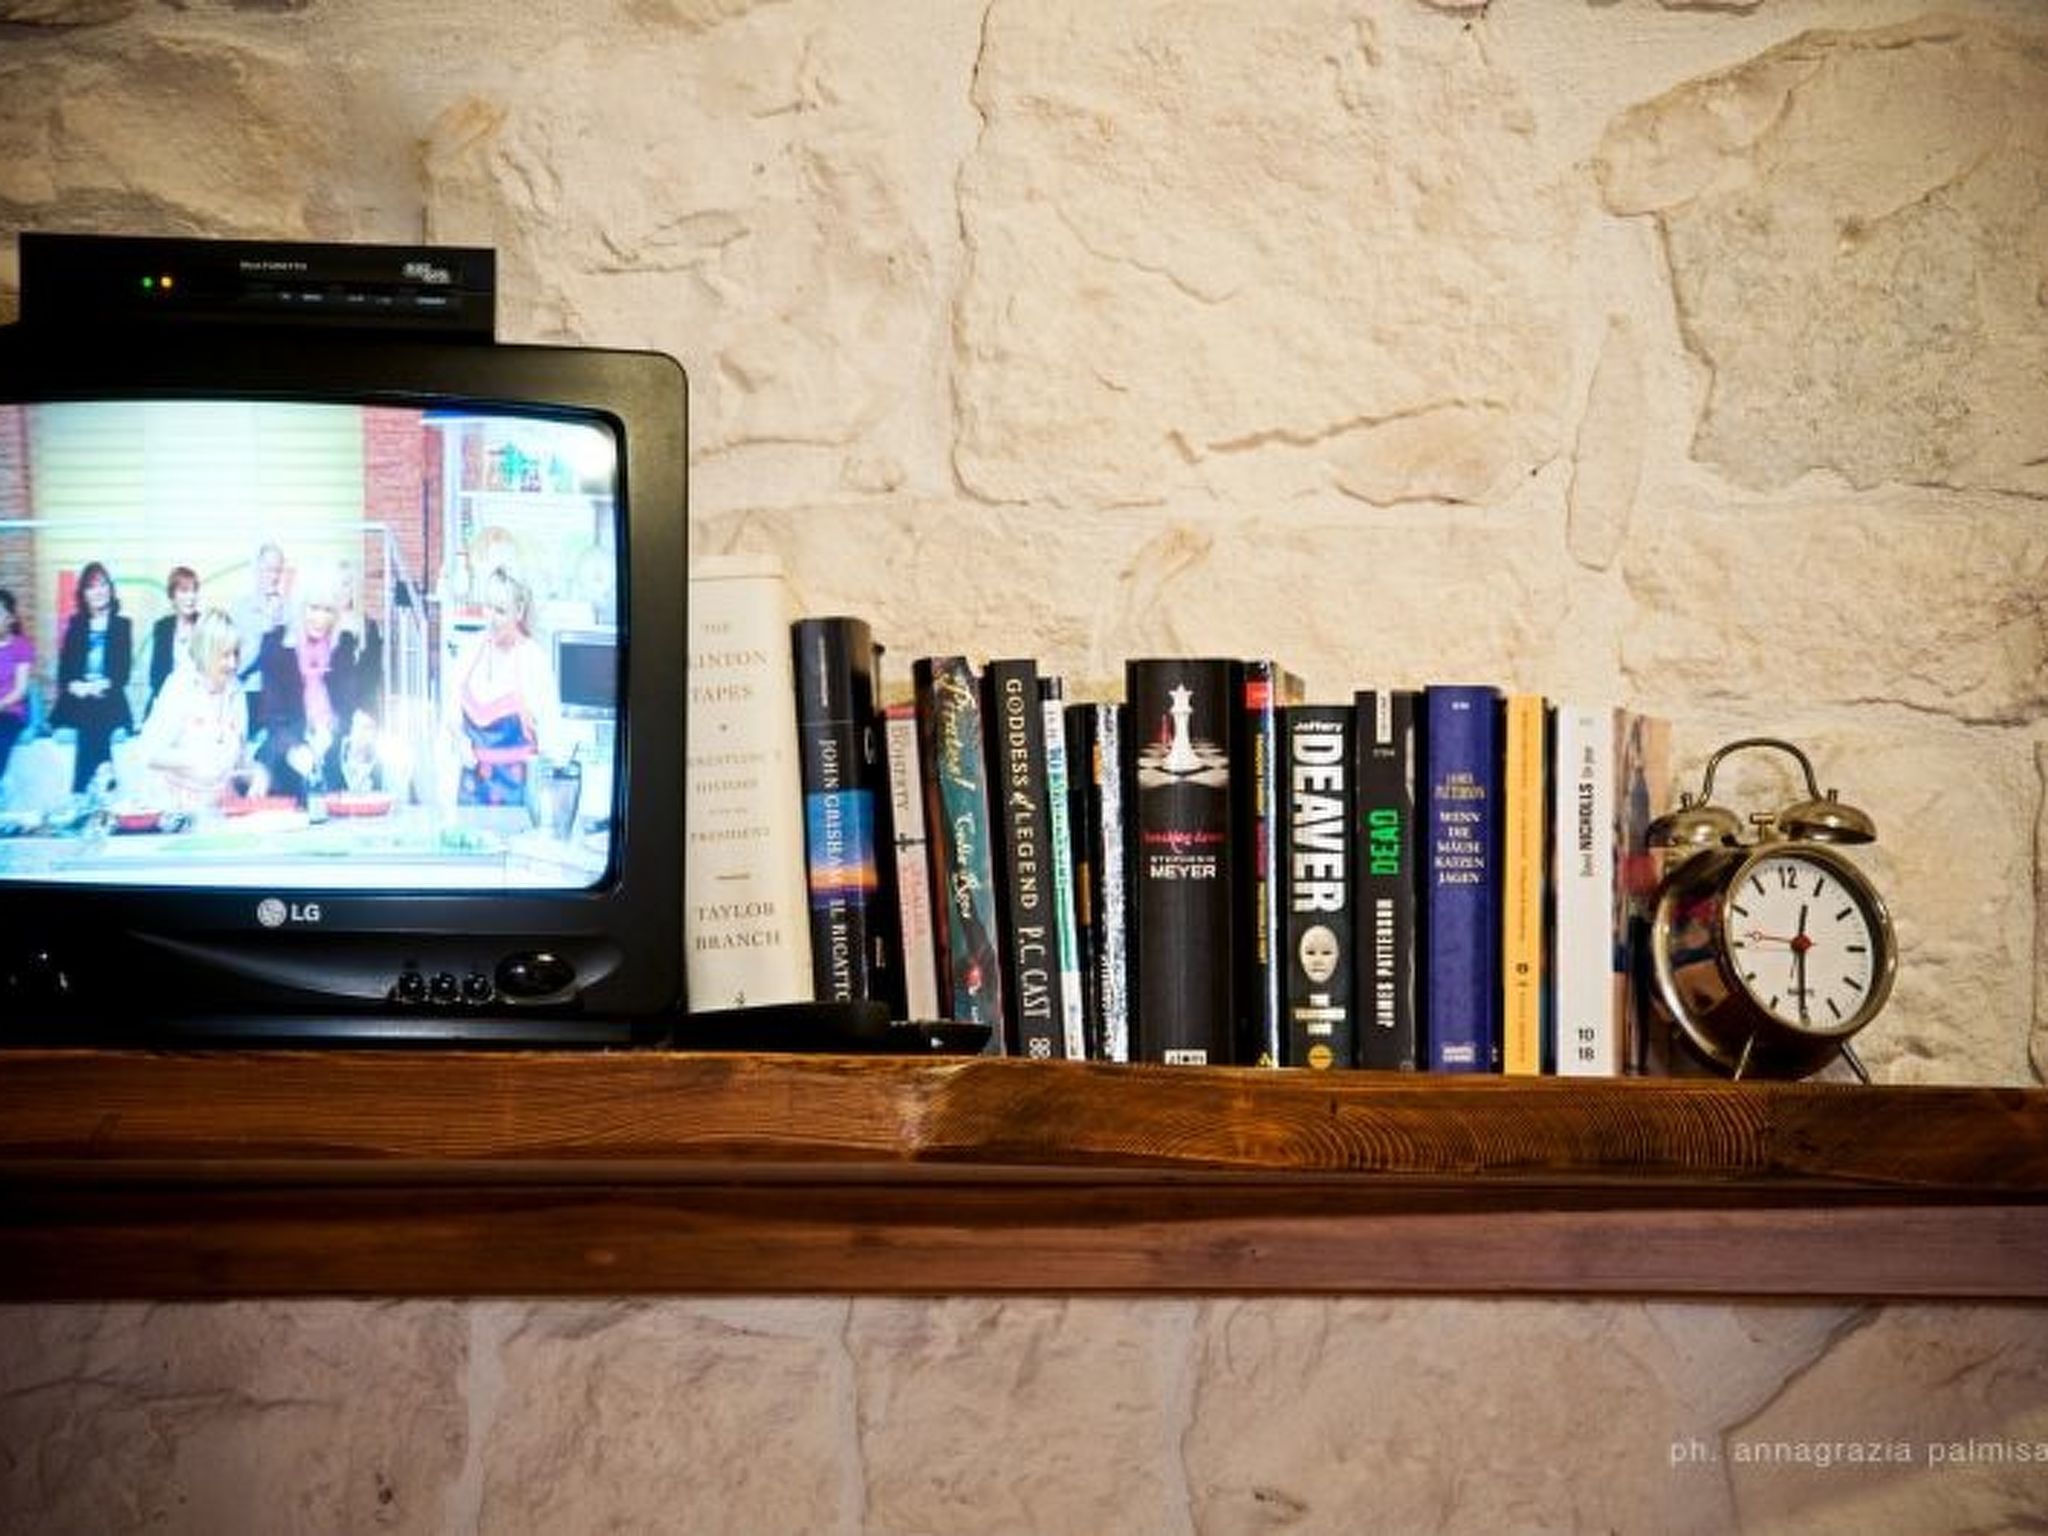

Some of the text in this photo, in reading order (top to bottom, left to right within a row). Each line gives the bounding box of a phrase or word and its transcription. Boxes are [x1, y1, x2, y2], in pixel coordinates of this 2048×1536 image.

[1005, 679, 1031, 786] GODDESS
[818, 739, 845, 888] JOHN GRISHAM
[1293, 733, 1344, 912] DEAVER
[1577, 783, 1593, 851] NICHOLLS
[1014, 811, 1039, 911] LEGEND
[1369, 808, 1401, 875] DEAD
[1150, 864, 1216, 880] MEYER
[1778, 866, 1799, 889] 12
[290, 904, 320, 922] LG
[698, 902, 775, 921] TAYLOR
[695, 930, 781, 951] BRANCH
[1376, 898, 1395, 1029] JAMES PATTERSON
[1022, 967, 1051, 1020] CAST
[1578, 1027, 1595, 1042] 10
[1578, 1047, 1595, 1062] 18
